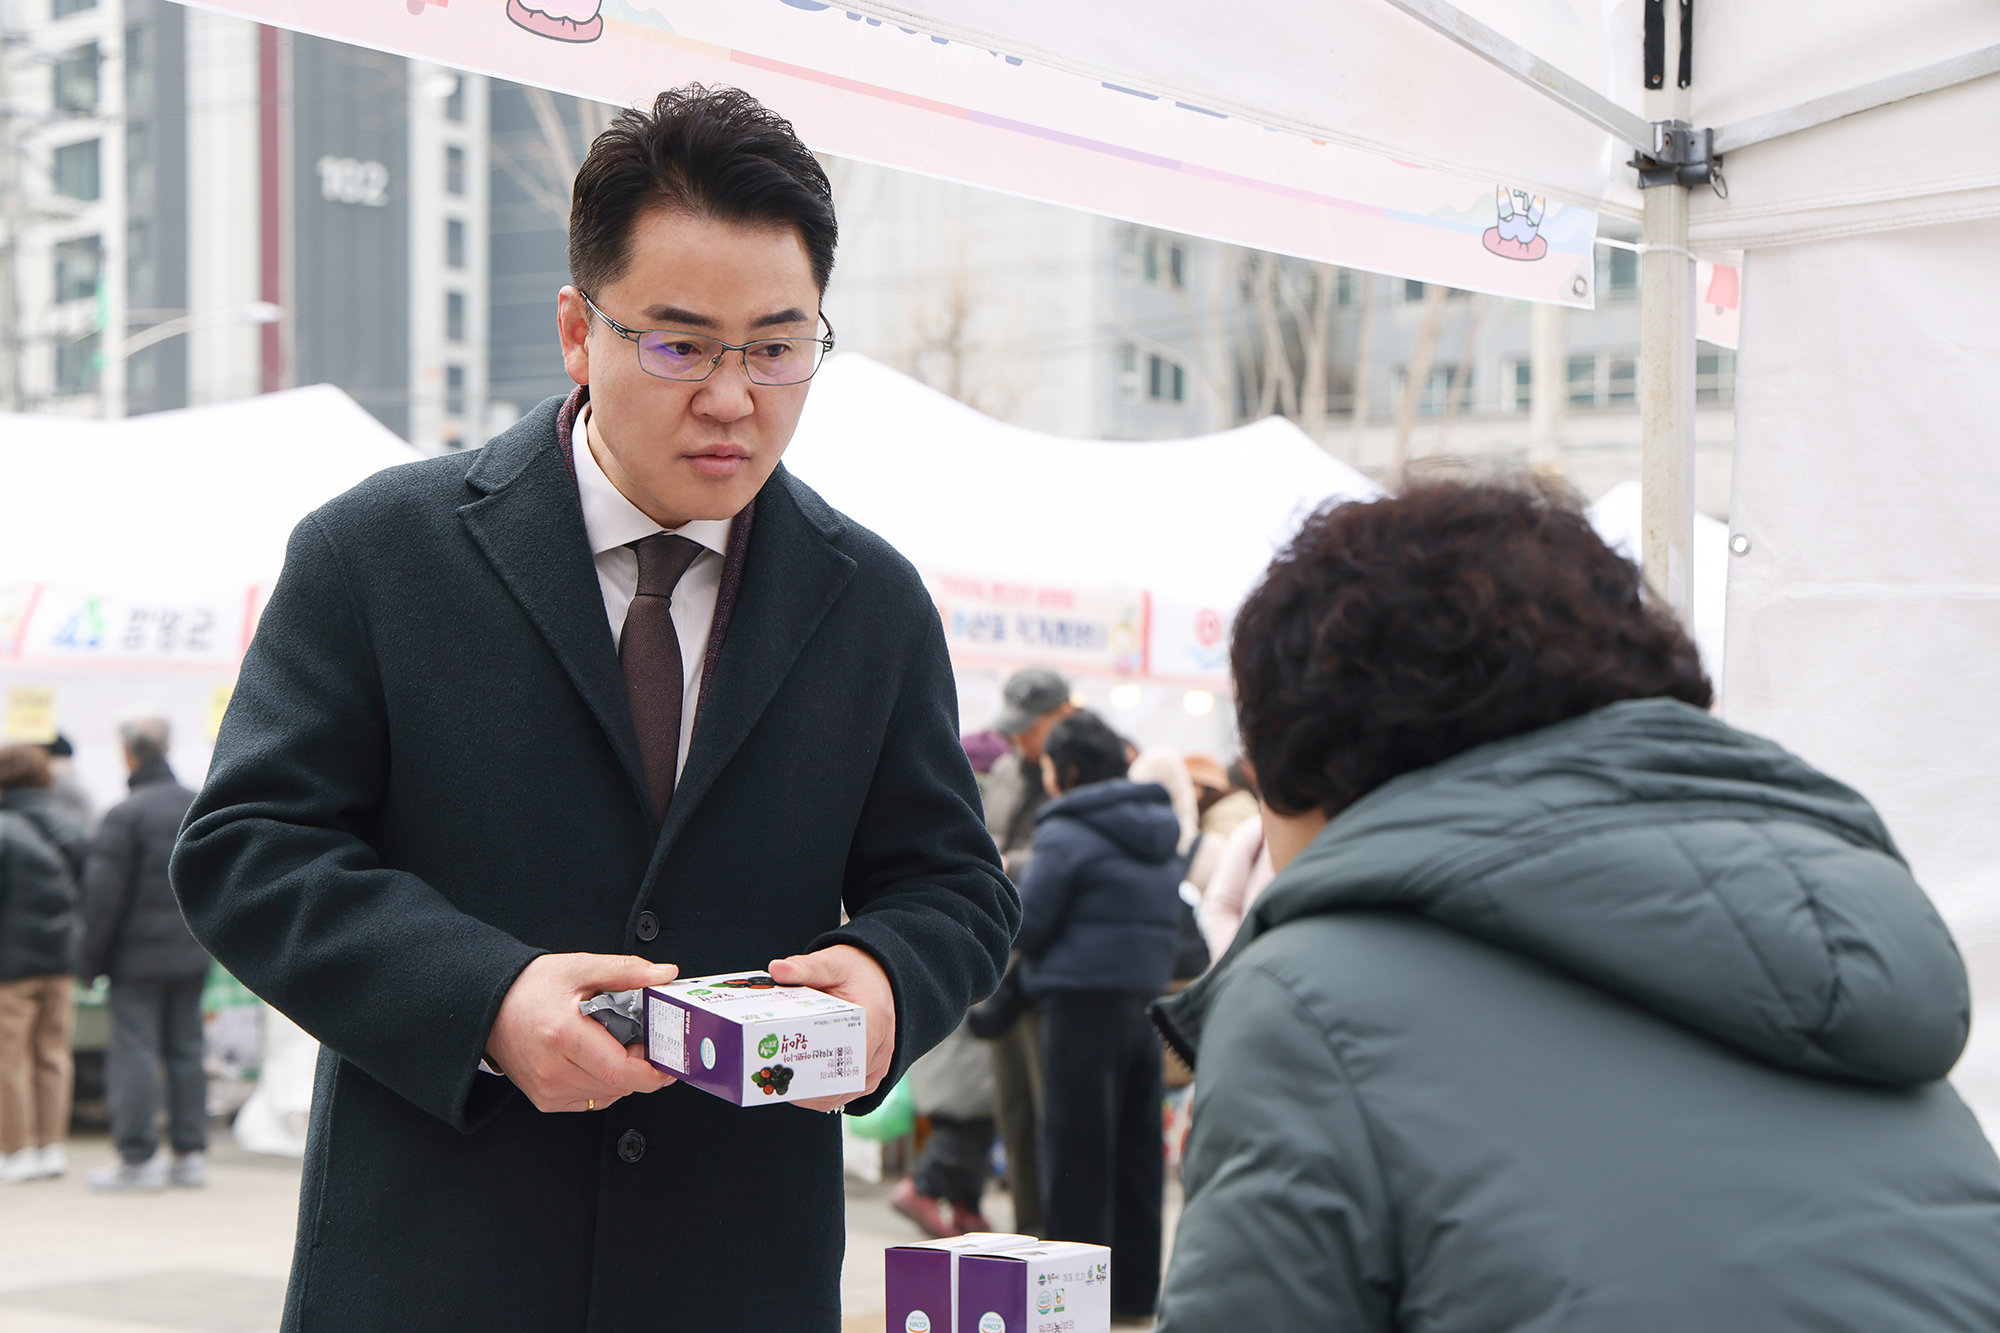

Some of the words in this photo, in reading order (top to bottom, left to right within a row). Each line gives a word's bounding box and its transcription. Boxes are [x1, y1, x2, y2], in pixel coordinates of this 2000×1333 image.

[317, 157, 388, 206] 102
[780, 1032, 808, 1053] 원액
[983, 1322, 1002, 1330] HACCP
